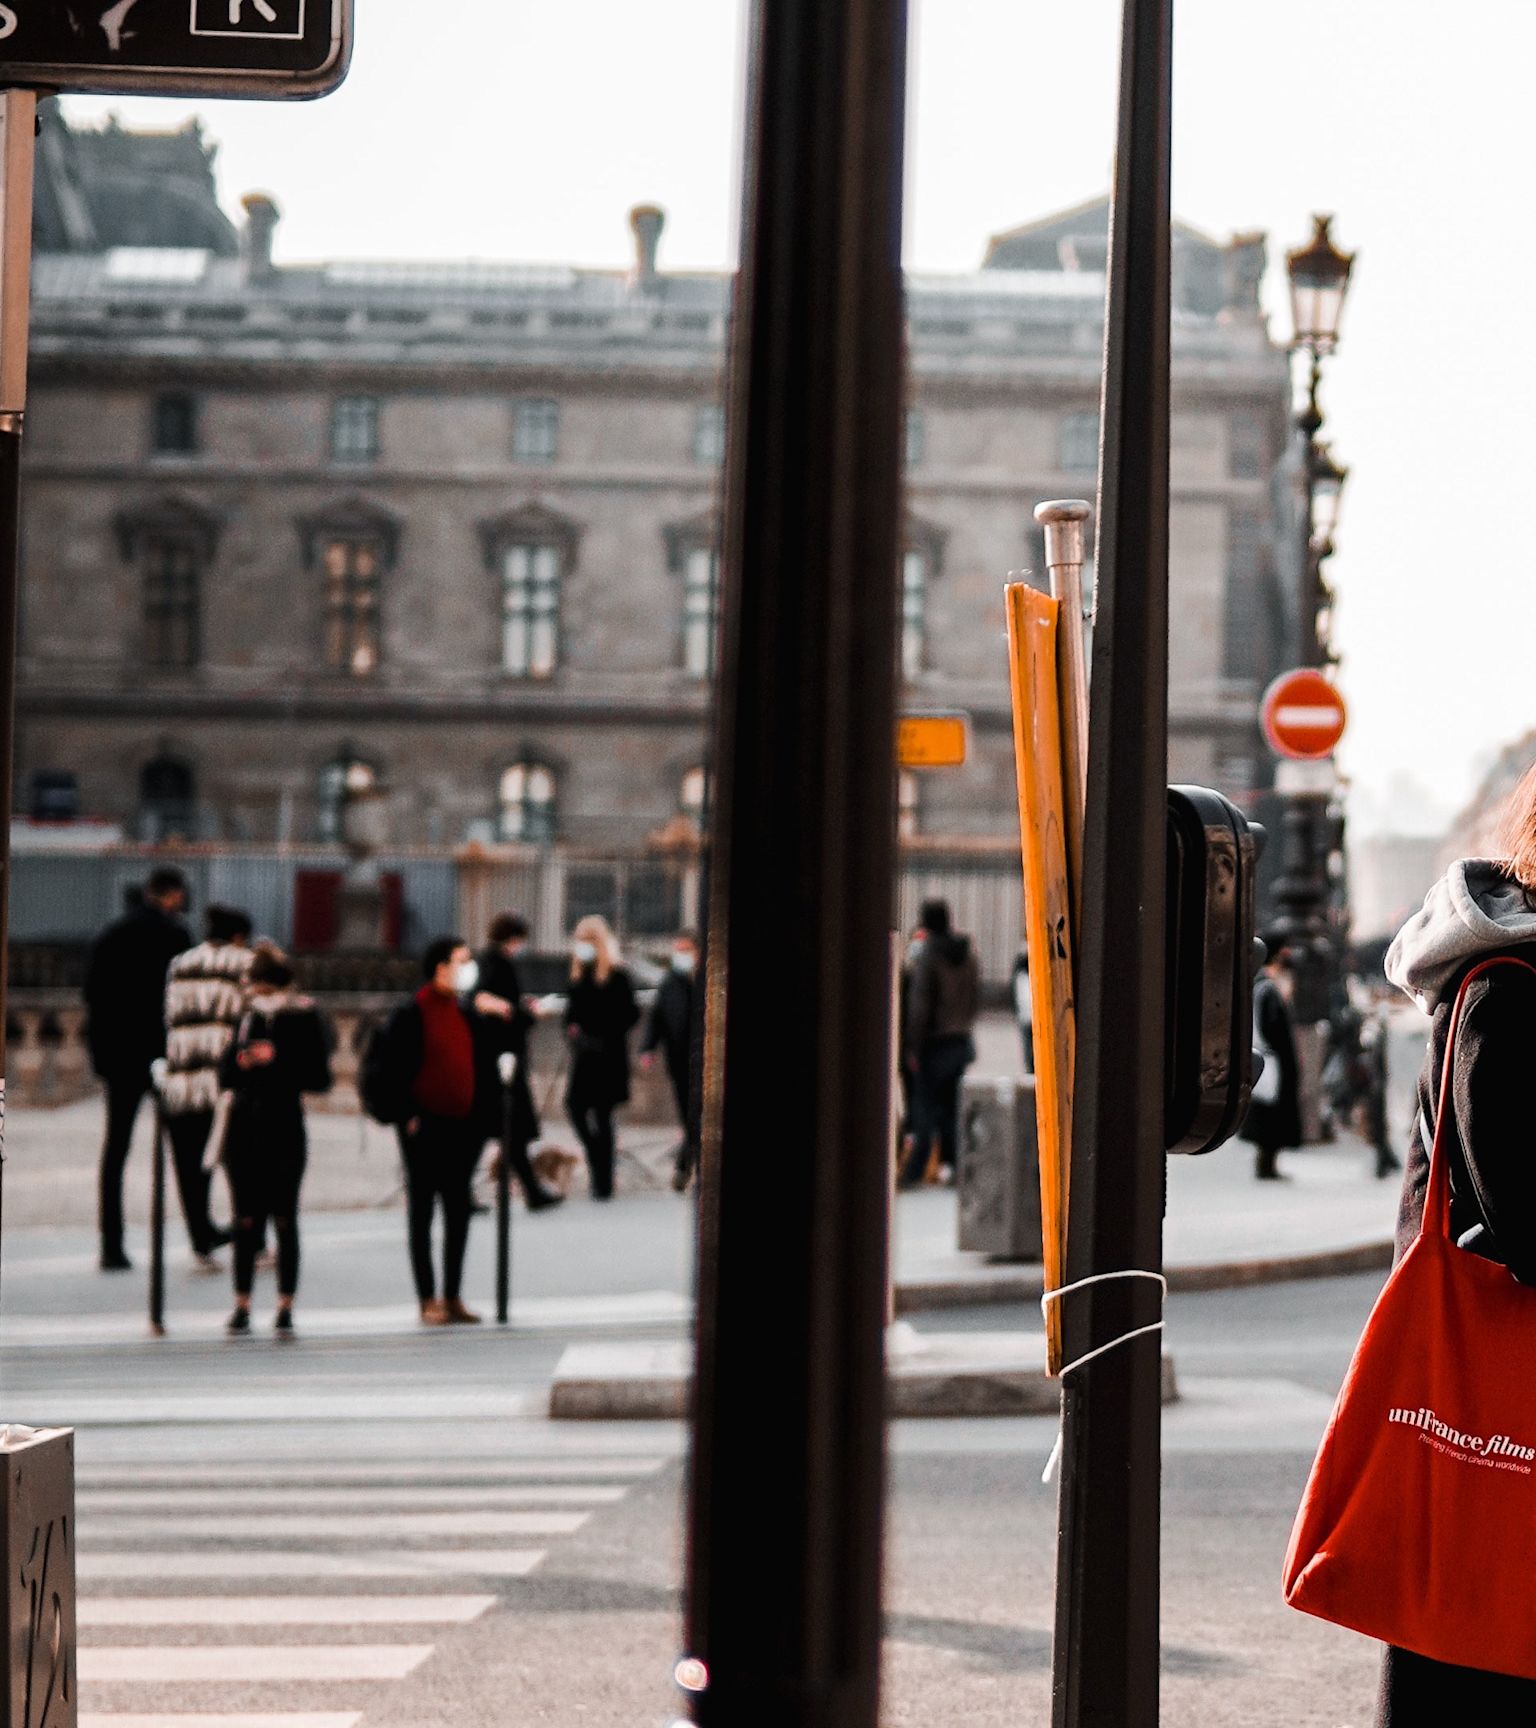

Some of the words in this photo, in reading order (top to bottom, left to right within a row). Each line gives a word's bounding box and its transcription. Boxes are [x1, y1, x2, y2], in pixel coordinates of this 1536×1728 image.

[1388, 1407, 1484, 1451] uniFrance
[1479, 1434, 1536, 1461] films
[1418, 1433, 1446, 1453] Proing
[1467, 1455, 1495, 1468] cinema
[1495, 1461, 1532, 1475] worldwide
